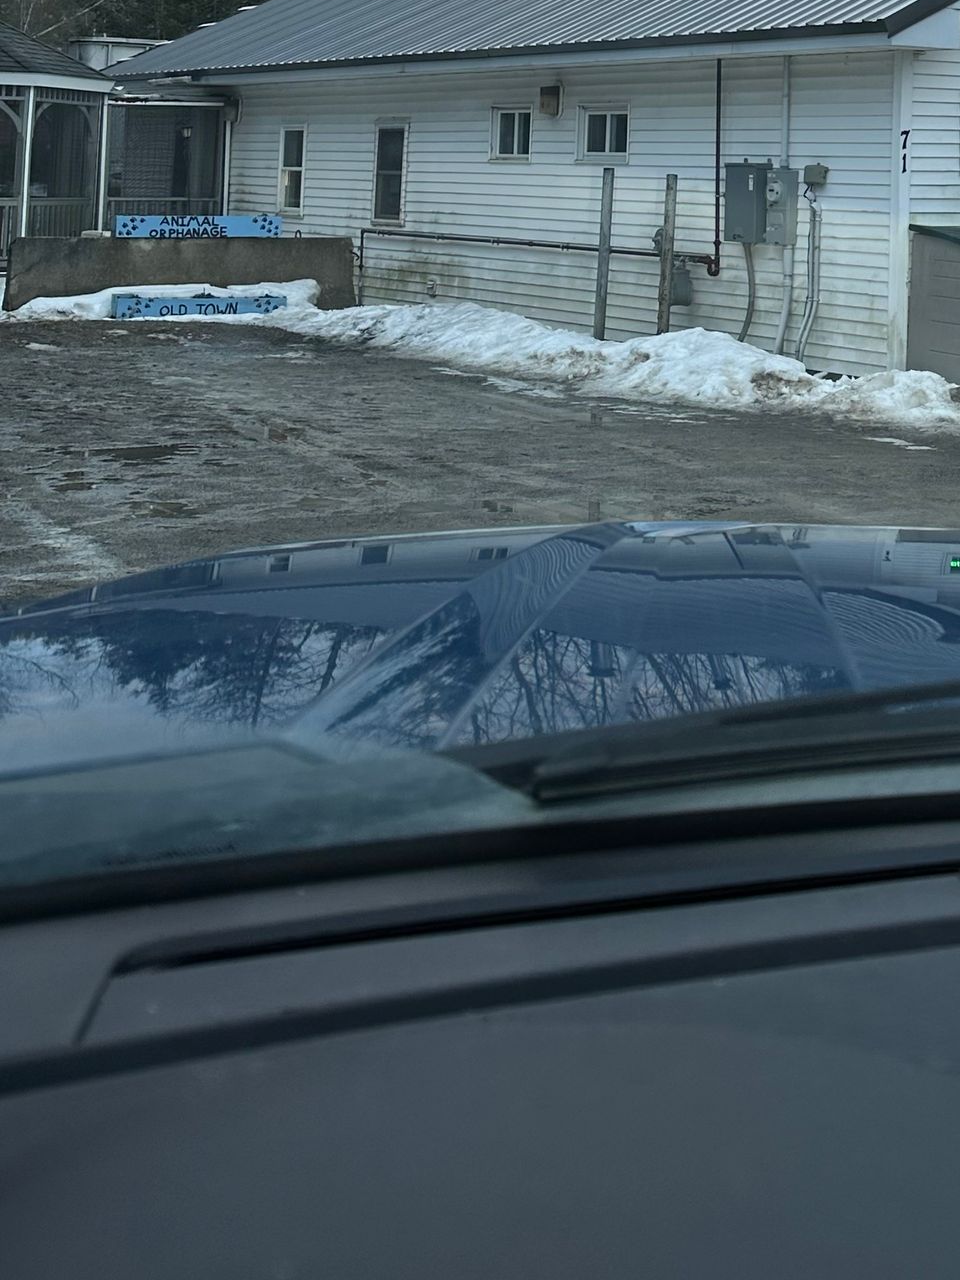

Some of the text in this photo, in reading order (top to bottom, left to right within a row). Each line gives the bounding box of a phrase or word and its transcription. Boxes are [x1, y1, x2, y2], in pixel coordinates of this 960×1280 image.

[900, 129, 911, 174] 71
[159, 216, 220, 227] ANIMAL
[149, 226, 228, 238] ORPHANAGE
[159, 302, 239, 317] OLD TOWN
